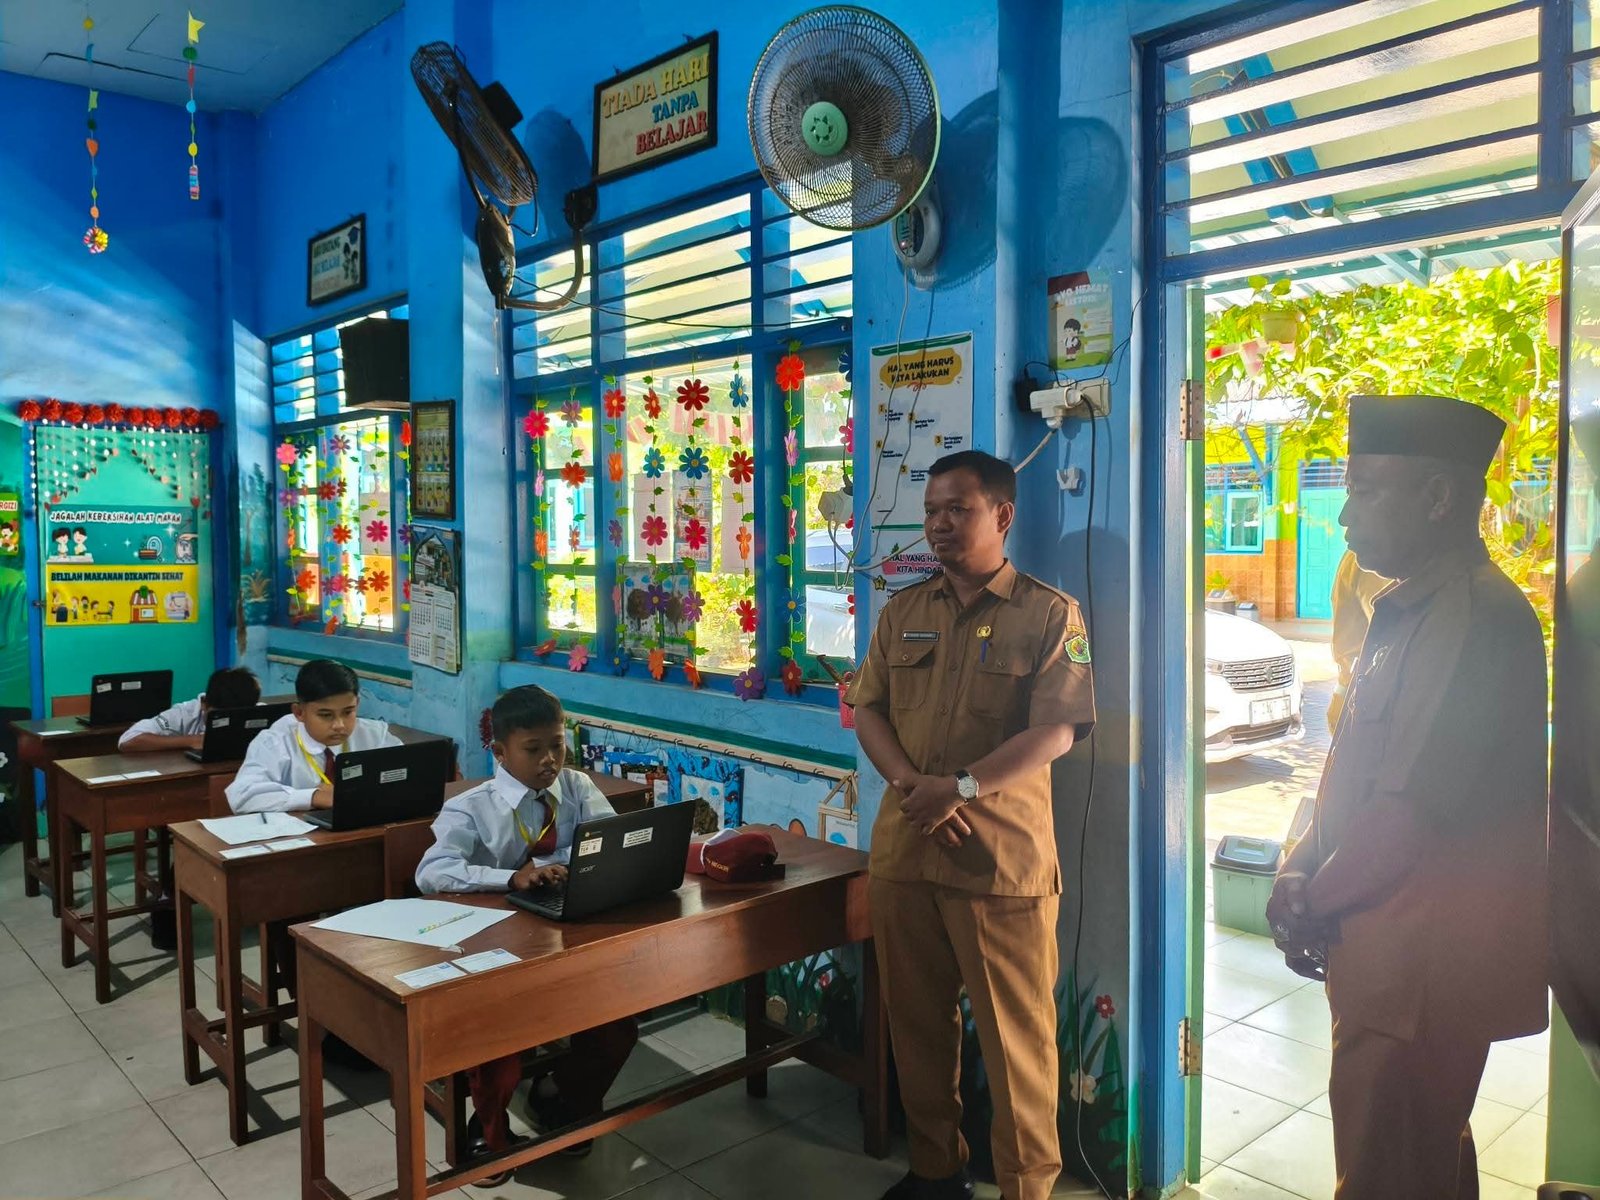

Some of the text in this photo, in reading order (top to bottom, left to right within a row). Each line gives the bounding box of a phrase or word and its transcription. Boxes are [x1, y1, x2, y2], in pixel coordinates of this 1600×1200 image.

[602, 54, 710, 118] TIADA HARI
[652, 90, 699, 123] TANPA
[635, 110, 709, 155] BELAJAR
[887, 356, 954, 374] HAL YANG HARUS
[911, 368, 950, 381] LAKUKAN
[50, 511, 182, 524] JAGALAH KEBERSIHAN ALAT MAKAN
[905, 554, 925, 562] YANG
[896, 565, 914, 573] KITA
[51, 572, 183, 582] BELILAH MAKANAN DIKANTIN SEHAT
